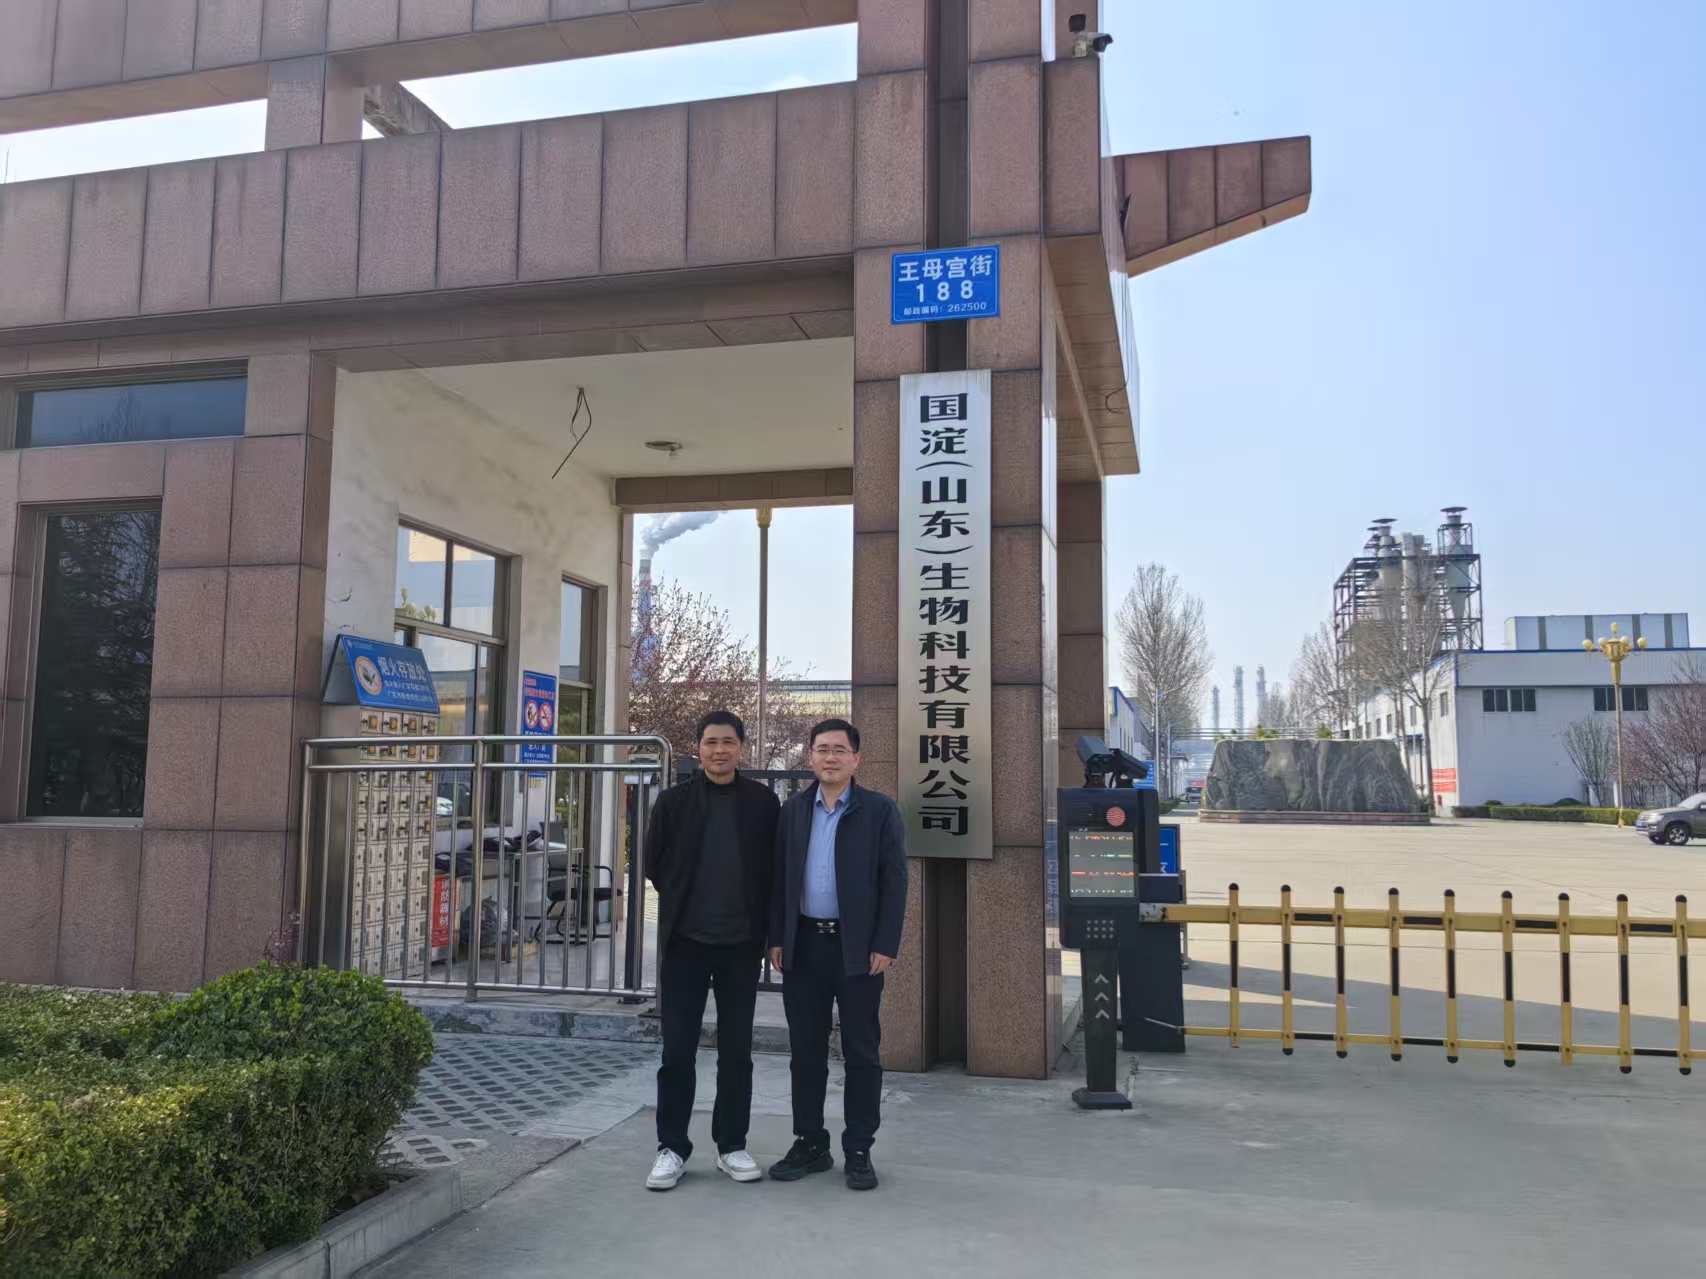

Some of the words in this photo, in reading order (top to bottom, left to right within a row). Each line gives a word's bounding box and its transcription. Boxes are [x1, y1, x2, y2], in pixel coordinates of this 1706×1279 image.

[898, 254, 993, 282] 王母宫街
[914, 392, 975, 837] 国淀(山东)生物科技有限公司
